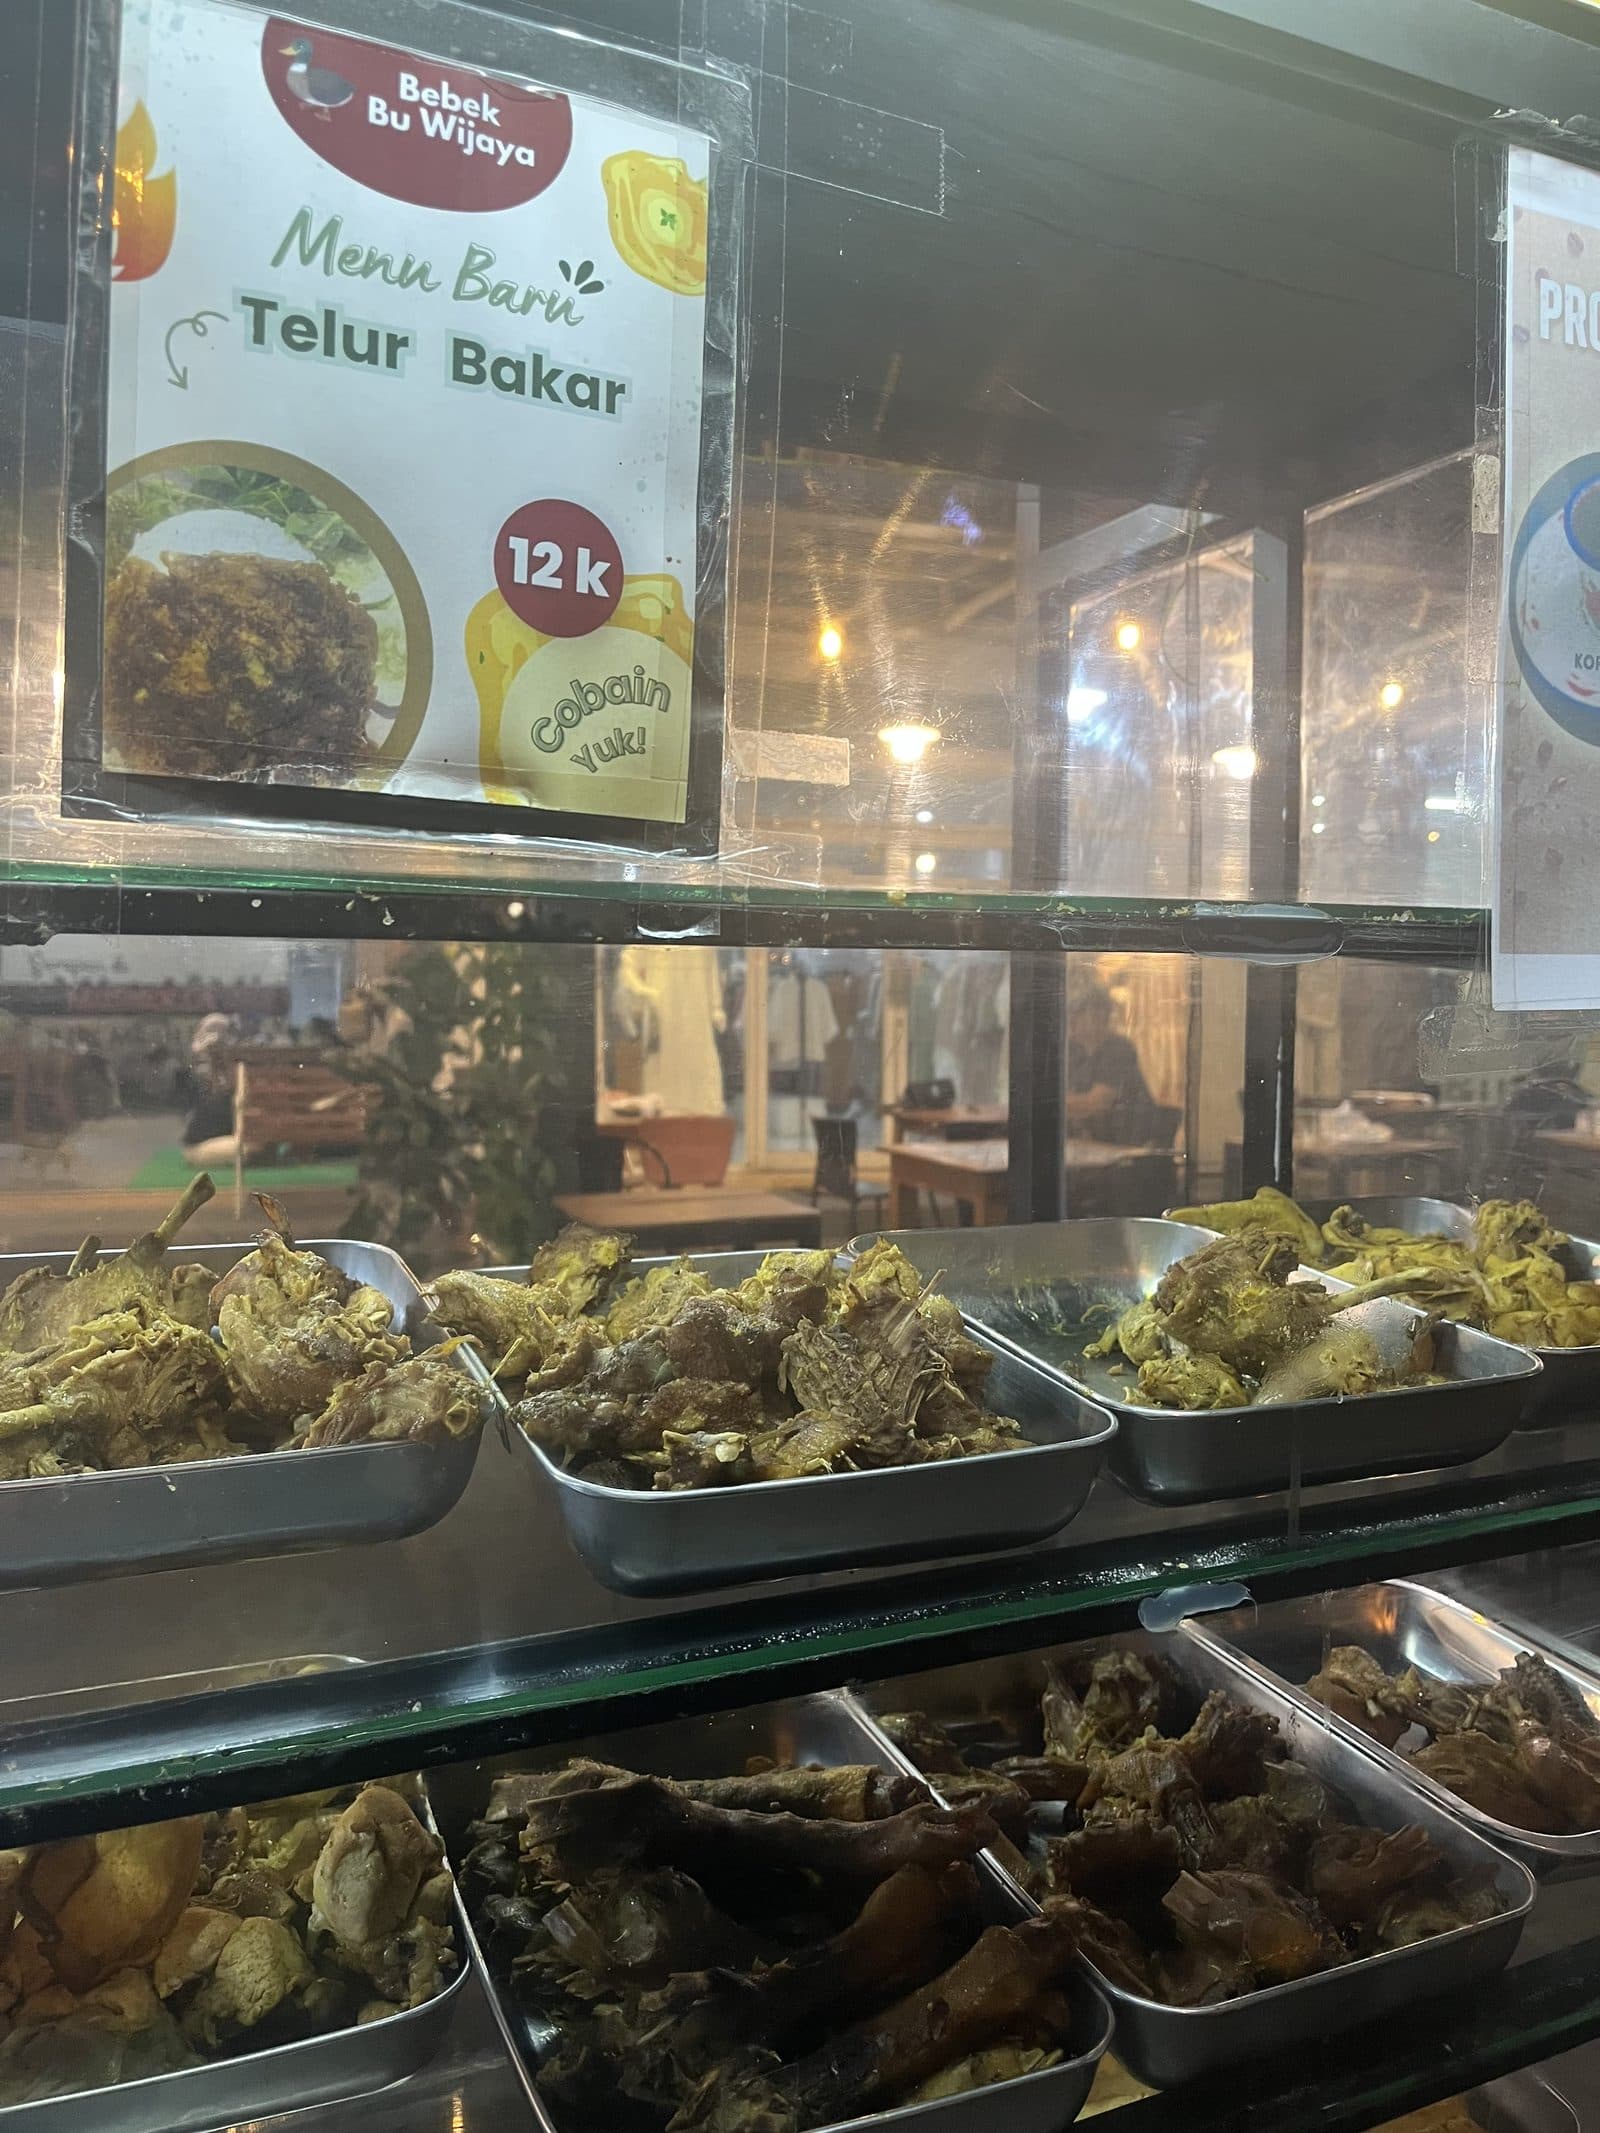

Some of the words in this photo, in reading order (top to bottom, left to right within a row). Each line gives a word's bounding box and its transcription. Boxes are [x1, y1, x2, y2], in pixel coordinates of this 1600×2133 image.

[368, 95, 411, 132] Bu
[419, 107, 535, 167] Wijaya
[400, 72, 501, 127] Bebek
[270, 205, 441, 292] Menu
[452, 242, 584, 327] Baru
[241, 296, 409, 370] Telur
[452, 337, 626, 414] Bakar
[508, 536, 564, 589] 12
[576, 547, 612, 598] k
[531, 665, 671, 753] Cobain
[570, 726, 647, 773] Yuk!
